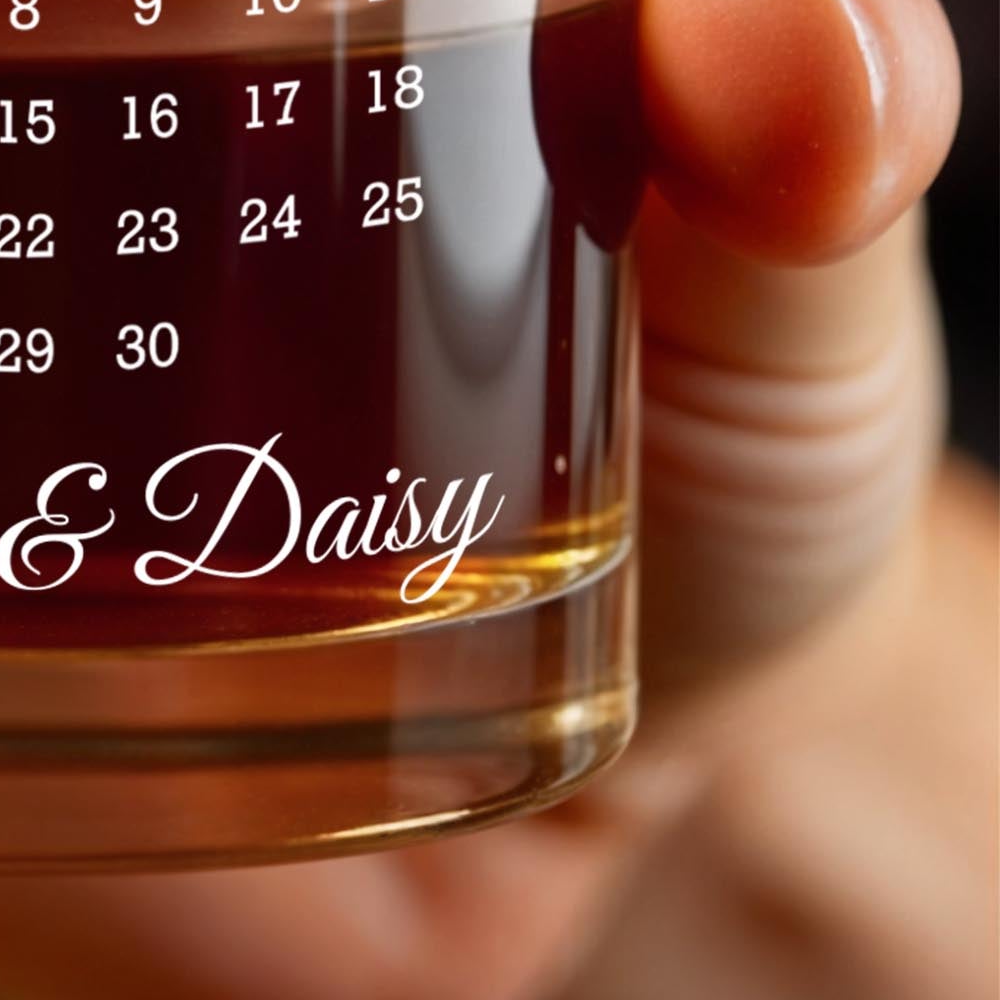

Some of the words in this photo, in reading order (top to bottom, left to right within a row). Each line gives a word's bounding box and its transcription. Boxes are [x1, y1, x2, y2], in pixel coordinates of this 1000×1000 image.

[122, 94, 178, 140] 16
[245, 81, 301, 130] 17
[367, 65, 425, 114] 18
[116, 207, 180, 255] 23
[239, 195, 302, 244] 24
[362, 176, 424, 228] 25
[115, 322, 179, 370] 30
[133, 431, 505, 604] Daisy
